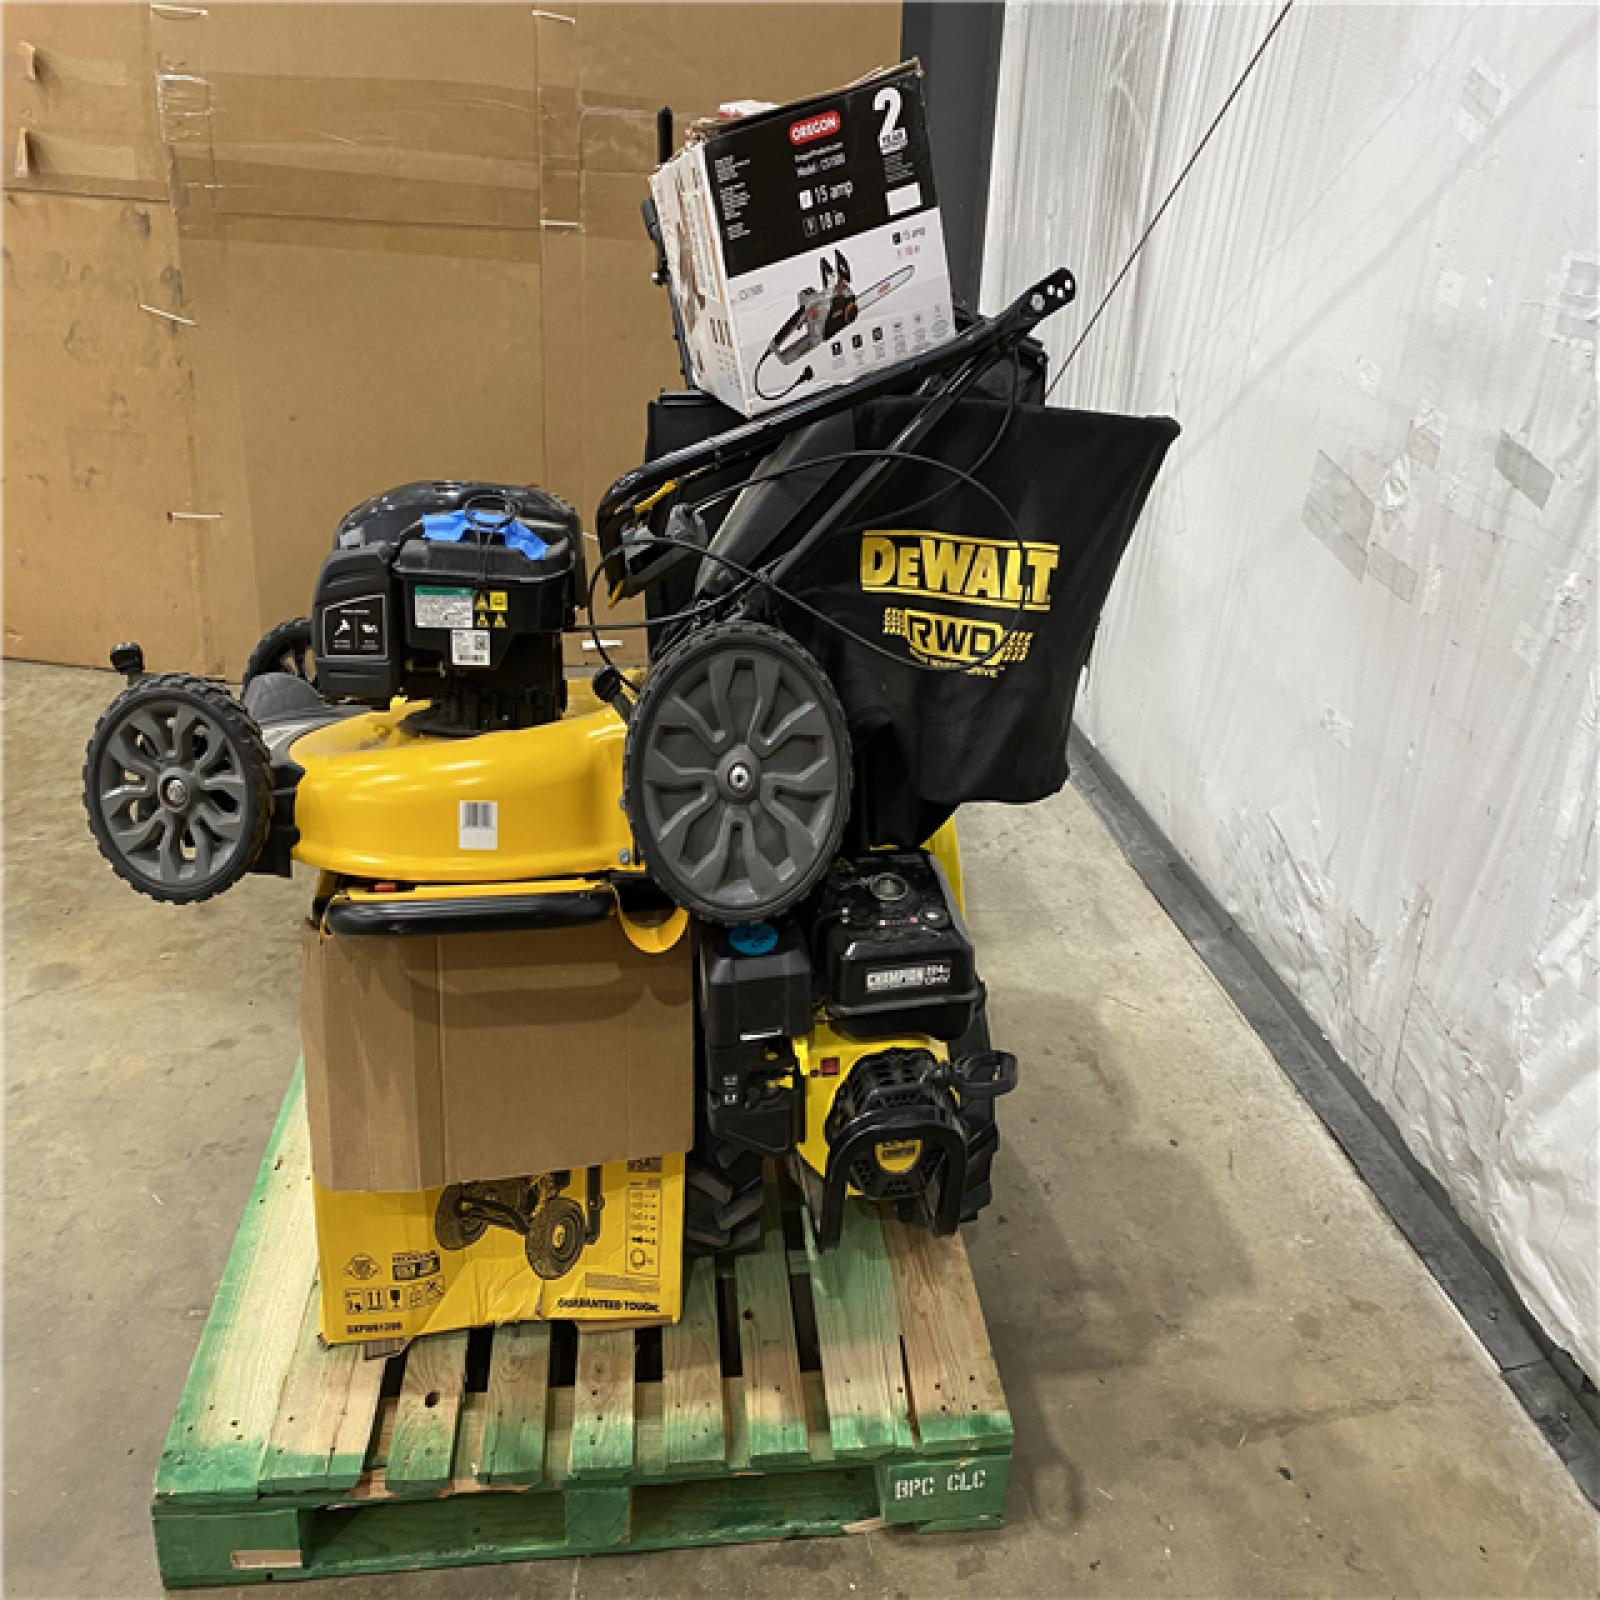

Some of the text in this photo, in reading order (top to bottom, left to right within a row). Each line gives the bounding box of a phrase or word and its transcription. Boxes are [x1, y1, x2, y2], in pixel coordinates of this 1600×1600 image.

[792, 115, 837, 141] OREGON
[873, 86, 907, 154] 2
[909, 613, 999, 658] RWD
[894, 1469, 986, 1500] BPC CLC
